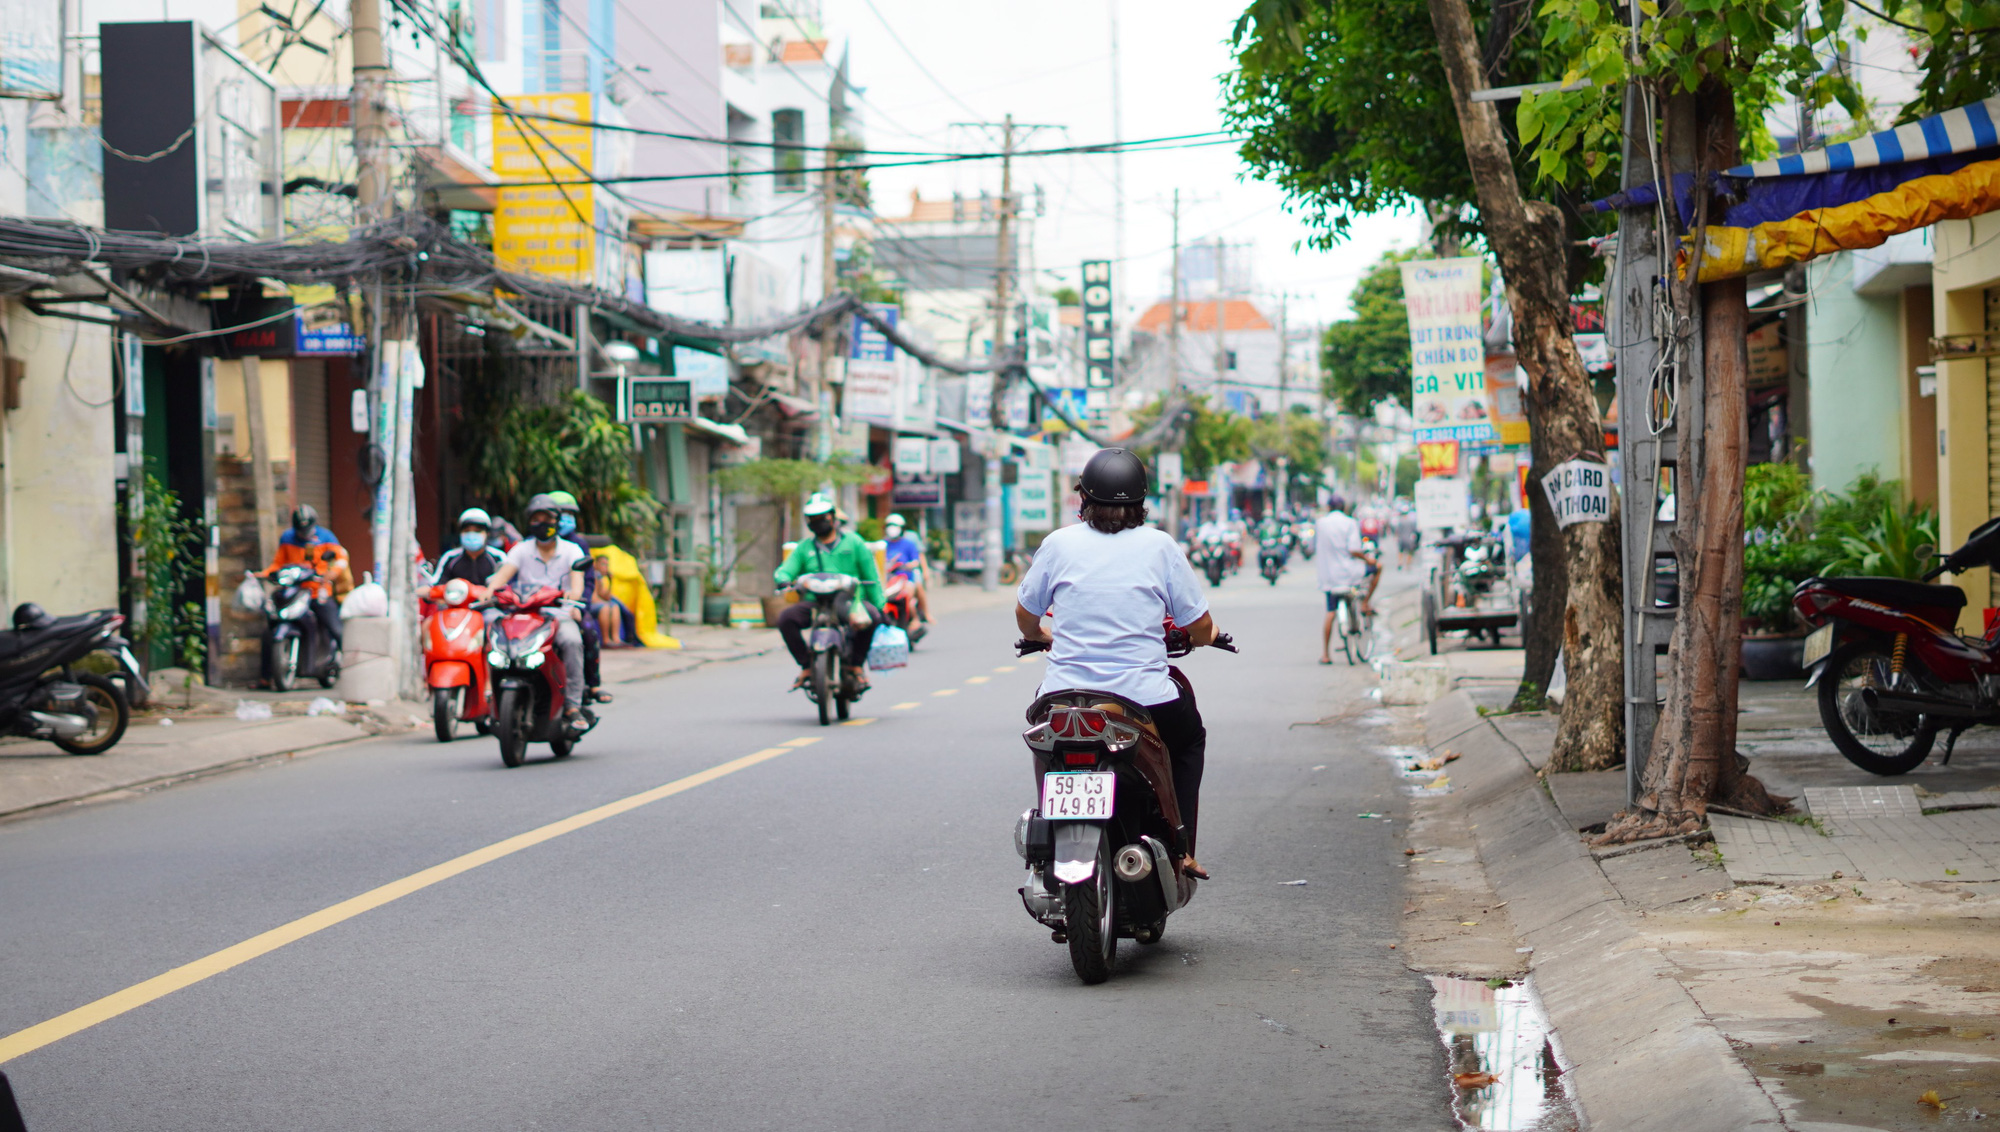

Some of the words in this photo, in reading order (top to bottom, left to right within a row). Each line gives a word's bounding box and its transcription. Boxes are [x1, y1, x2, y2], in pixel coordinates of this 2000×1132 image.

[1084, 262, 1112, 388] HOTEL
[1454, 371, 1485, 395] VỊT
[1564, 468, 1603, 488] CARD
[1564, 494, 1606, 518] THOẠI
[1055, 776, 1103, 795] 59-C3
[1048, 796, 1106, 816] 149.81
